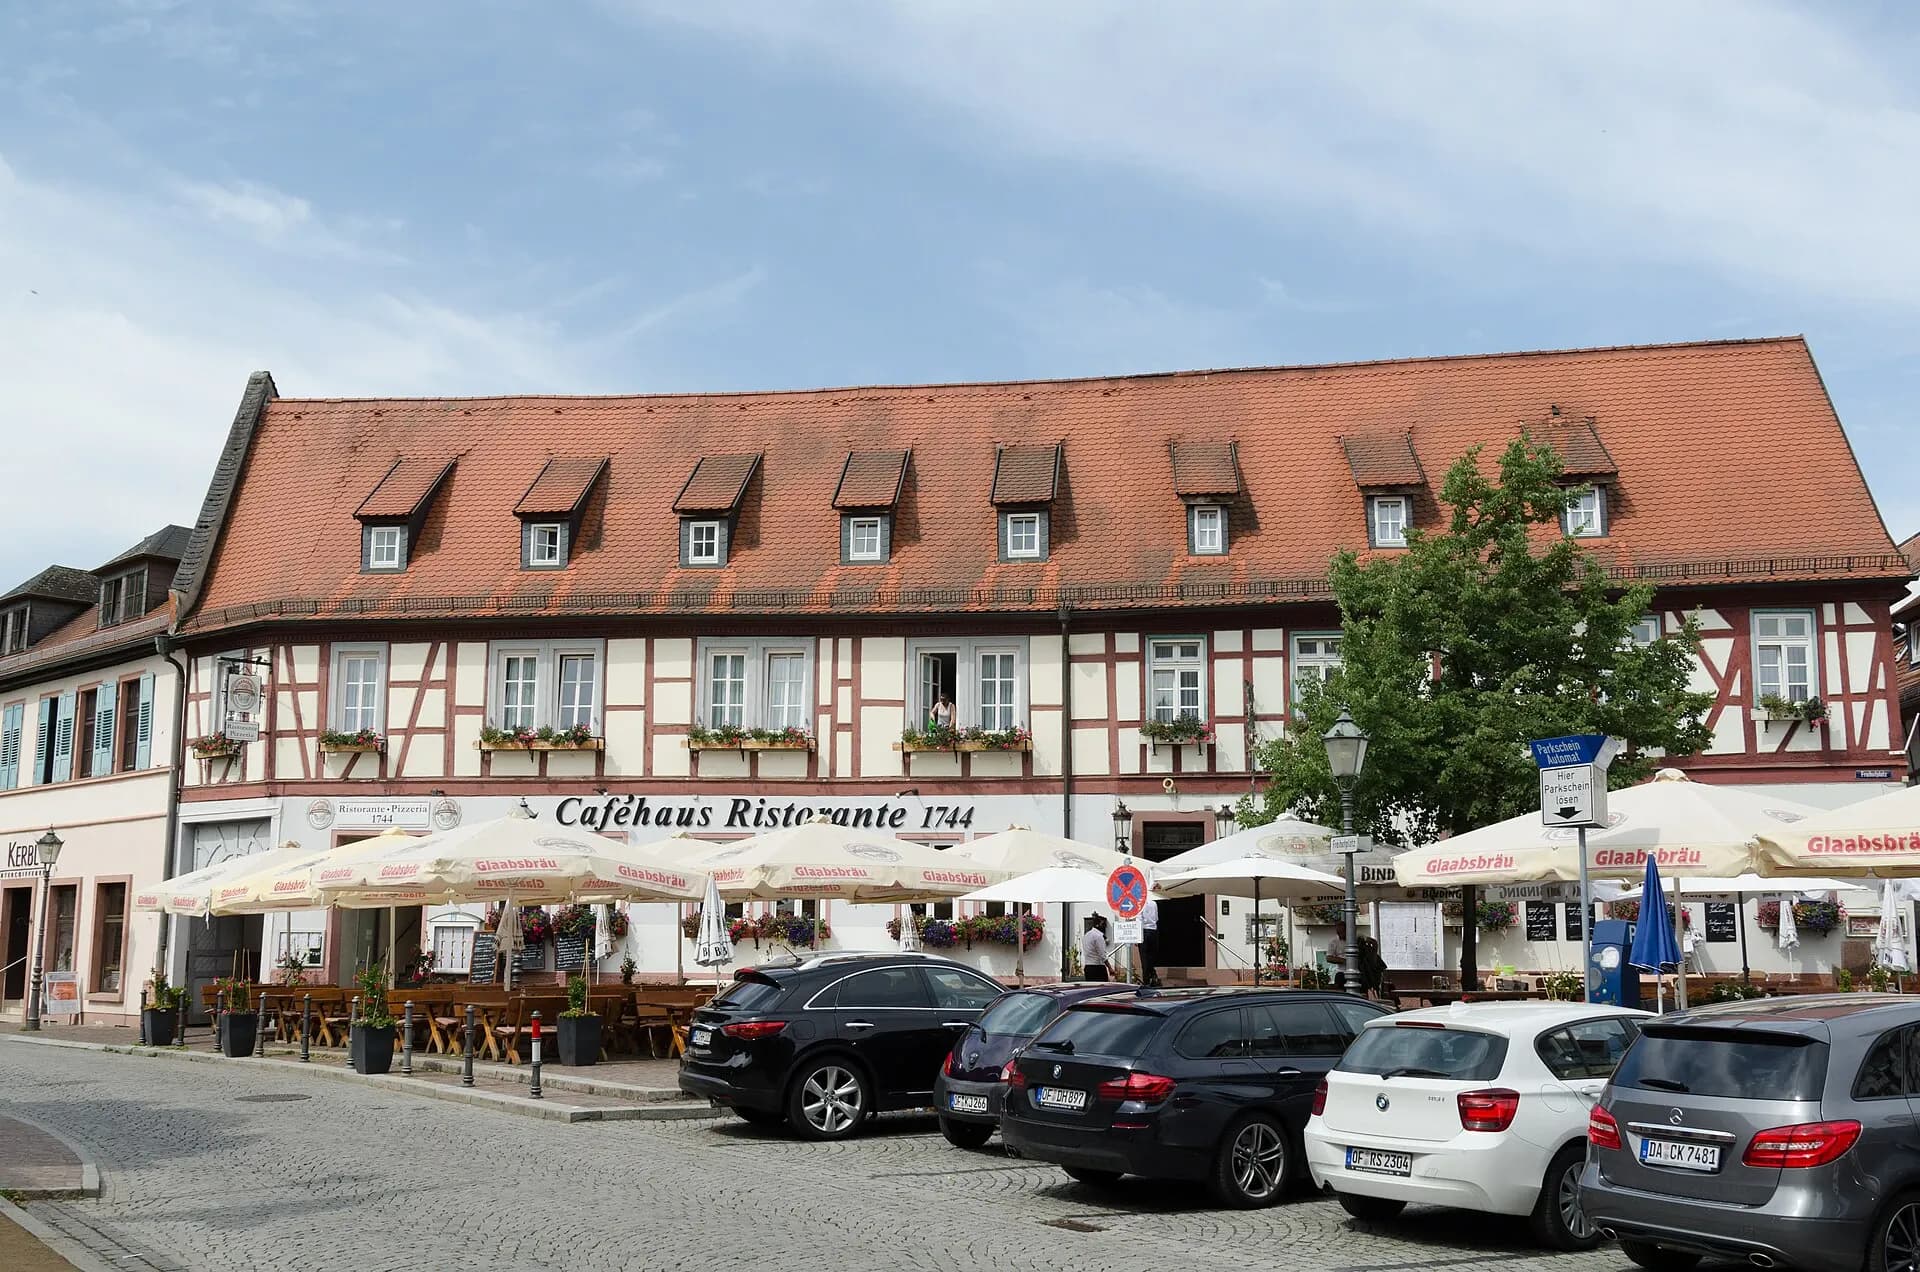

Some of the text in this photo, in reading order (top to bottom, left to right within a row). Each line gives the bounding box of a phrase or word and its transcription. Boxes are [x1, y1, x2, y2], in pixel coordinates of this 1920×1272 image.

[1536, 740, 1581, 754] Parkschein
[1547, 751, 1580, 765] Automat
[1557, 772, 1575, 781] Hier
[1544, 782, 1590, 794] Parkschein
[1556, 794, 1579, 805] lösen
[339, 804, 428, 813] Ristorante Pizzeria
[555, 794, 713, 831] Caféhaus
[920, 805, 975, 829] 1744
[371, 815, 393, 824] 1744
[1426, 854, 1514, 873] Glaabsbräu
[1595, 847, 1702, 866] Glaabbräu
[475, 858, 558, 872] Glaabsbräu
[794, 866, 868, 878] Glaabsbräu
[618, 864, 686, 888] Glaabsbräu
[922, 870, 986, 885] Glaabsbräu
[1042, 1088, 1053, 1101] OF
[1352, 1150, 1409, 1170] OF RS 2304
[1648, 1142, 1716, 1165] DA CK 7481
